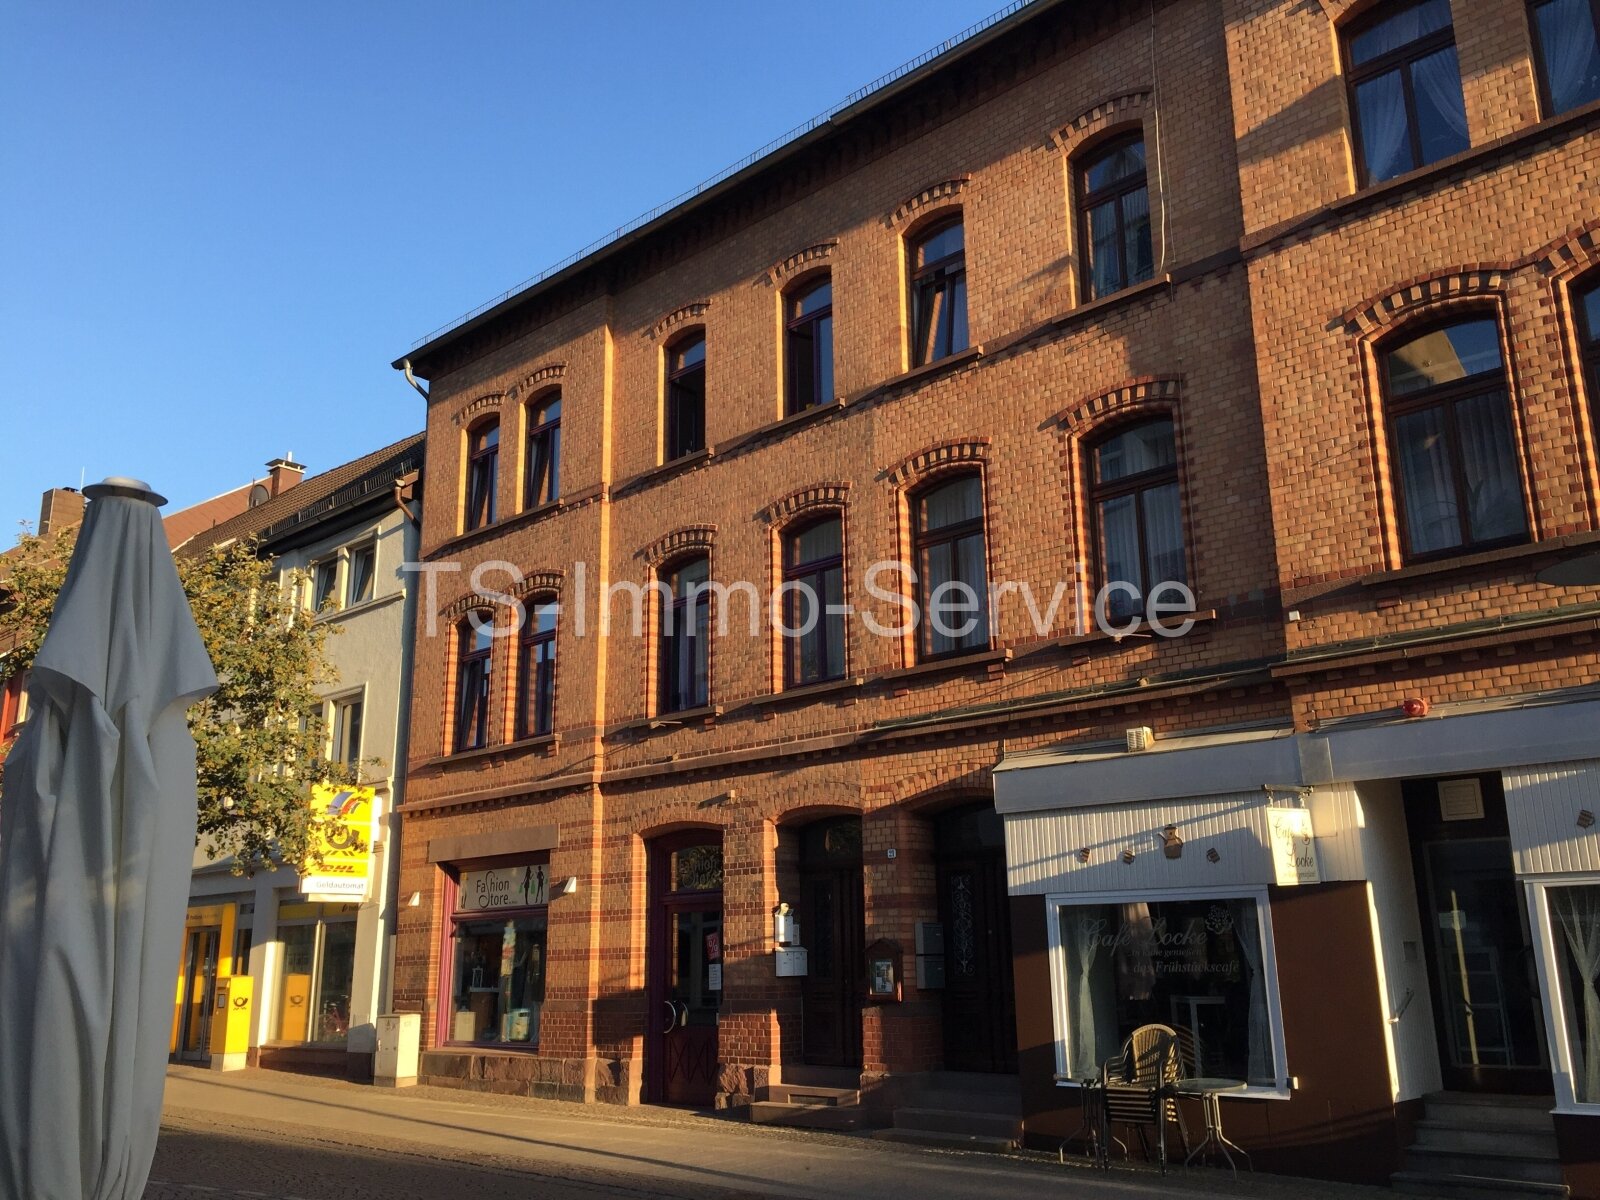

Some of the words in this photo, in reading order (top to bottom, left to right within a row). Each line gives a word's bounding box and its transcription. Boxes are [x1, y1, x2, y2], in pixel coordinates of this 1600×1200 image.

[1286, 842, 1314, 868] Locke
[319, 864, 355, 873] DHL
[316, 881, 364, 889] Geldautomat
[476, 871, 510, 894] Fashion
[1141, 916, 1208, 946] Locke
[1155, 960, 1240, 977] Frühstückscafé
